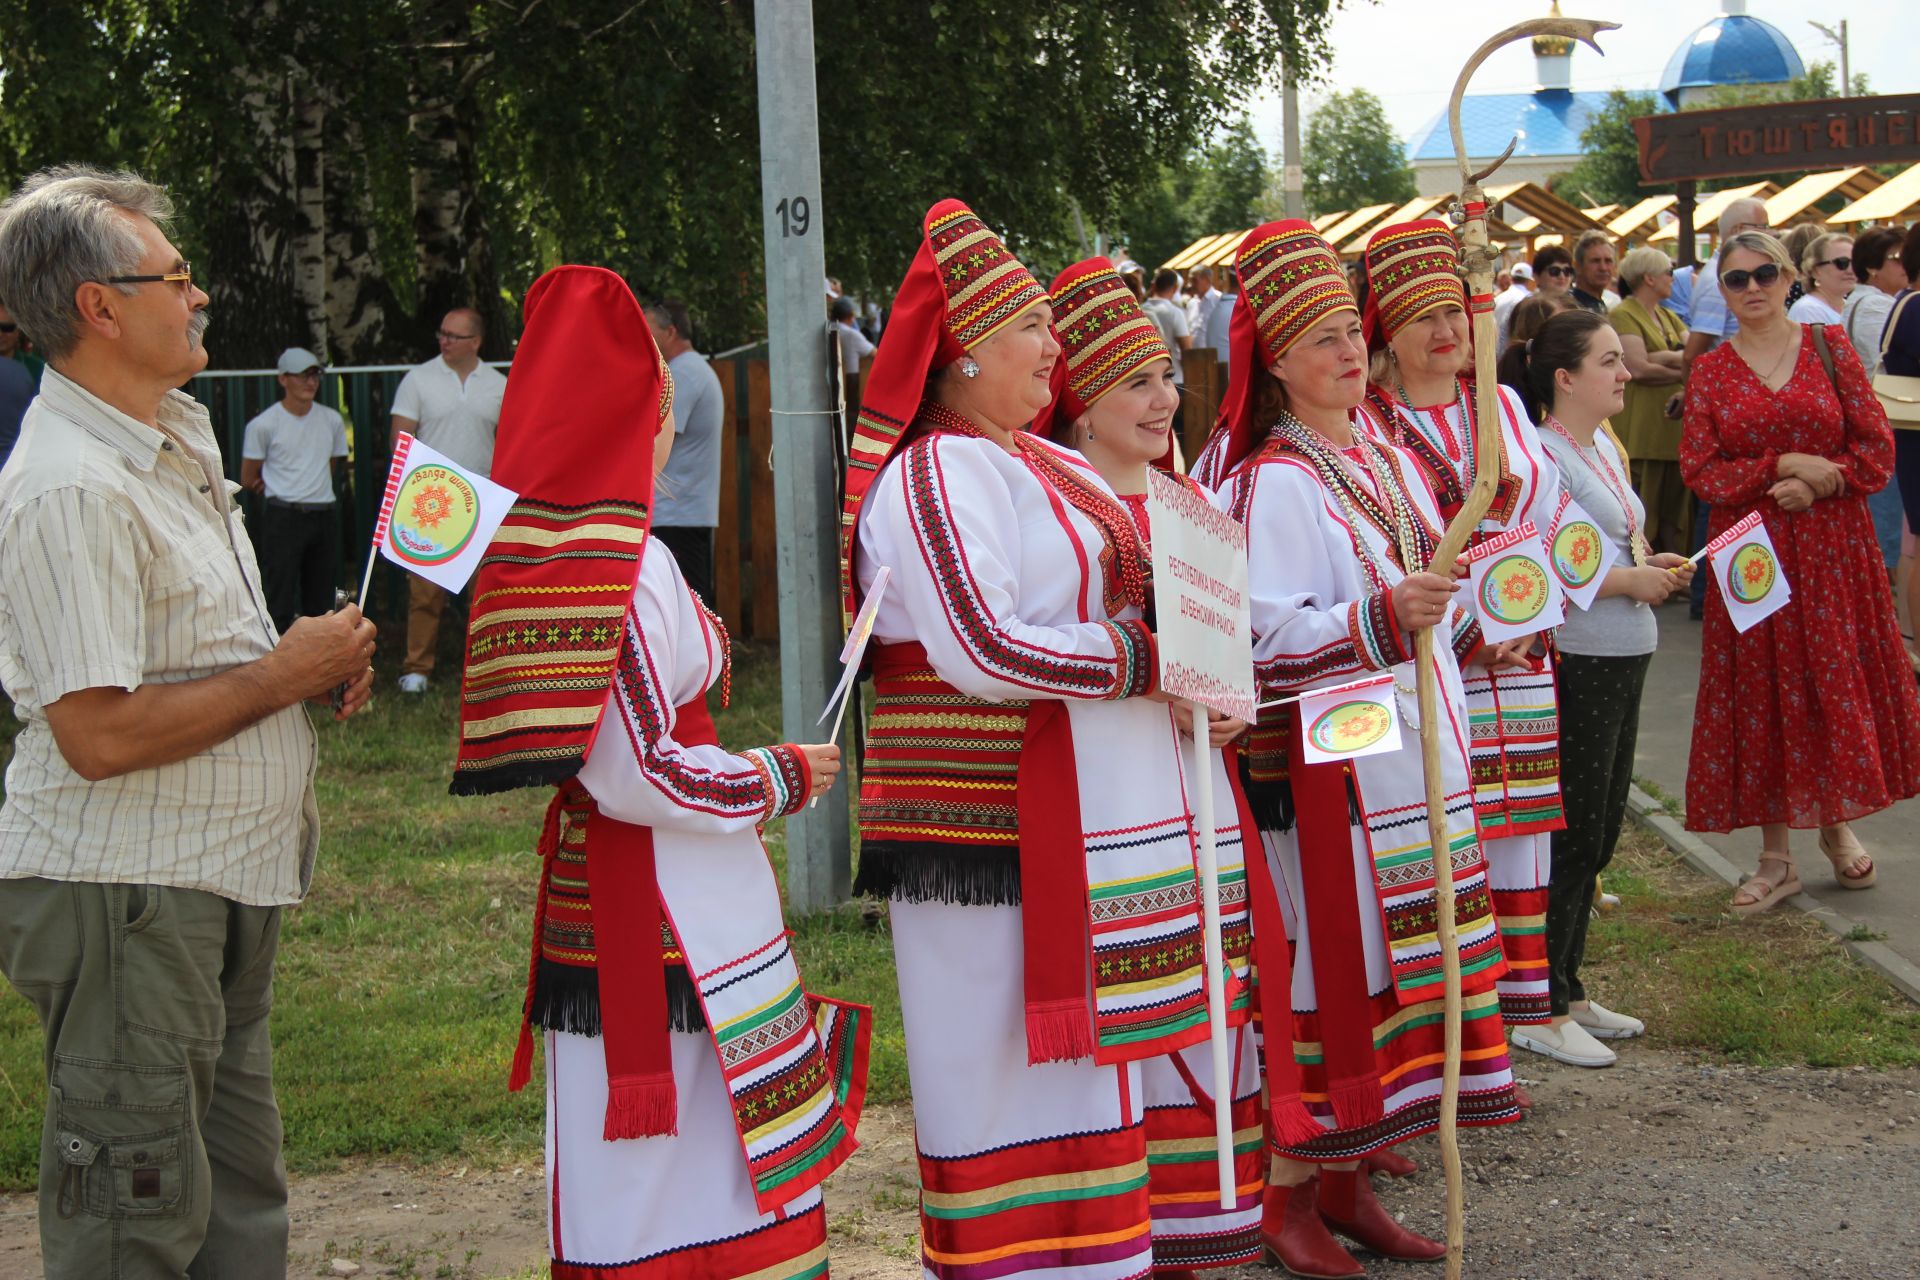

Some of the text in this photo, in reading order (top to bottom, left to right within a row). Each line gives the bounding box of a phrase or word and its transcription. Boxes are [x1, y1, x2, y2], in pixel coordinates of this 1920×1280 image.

[776, 195, 810, 238] 19
[1168, 555, 1241, 610] РЕСПУБЛИКА МОРДОВИЯ
[1180, 594, 1236, 639] ДУБЕНСКИЙ РАЙОН
